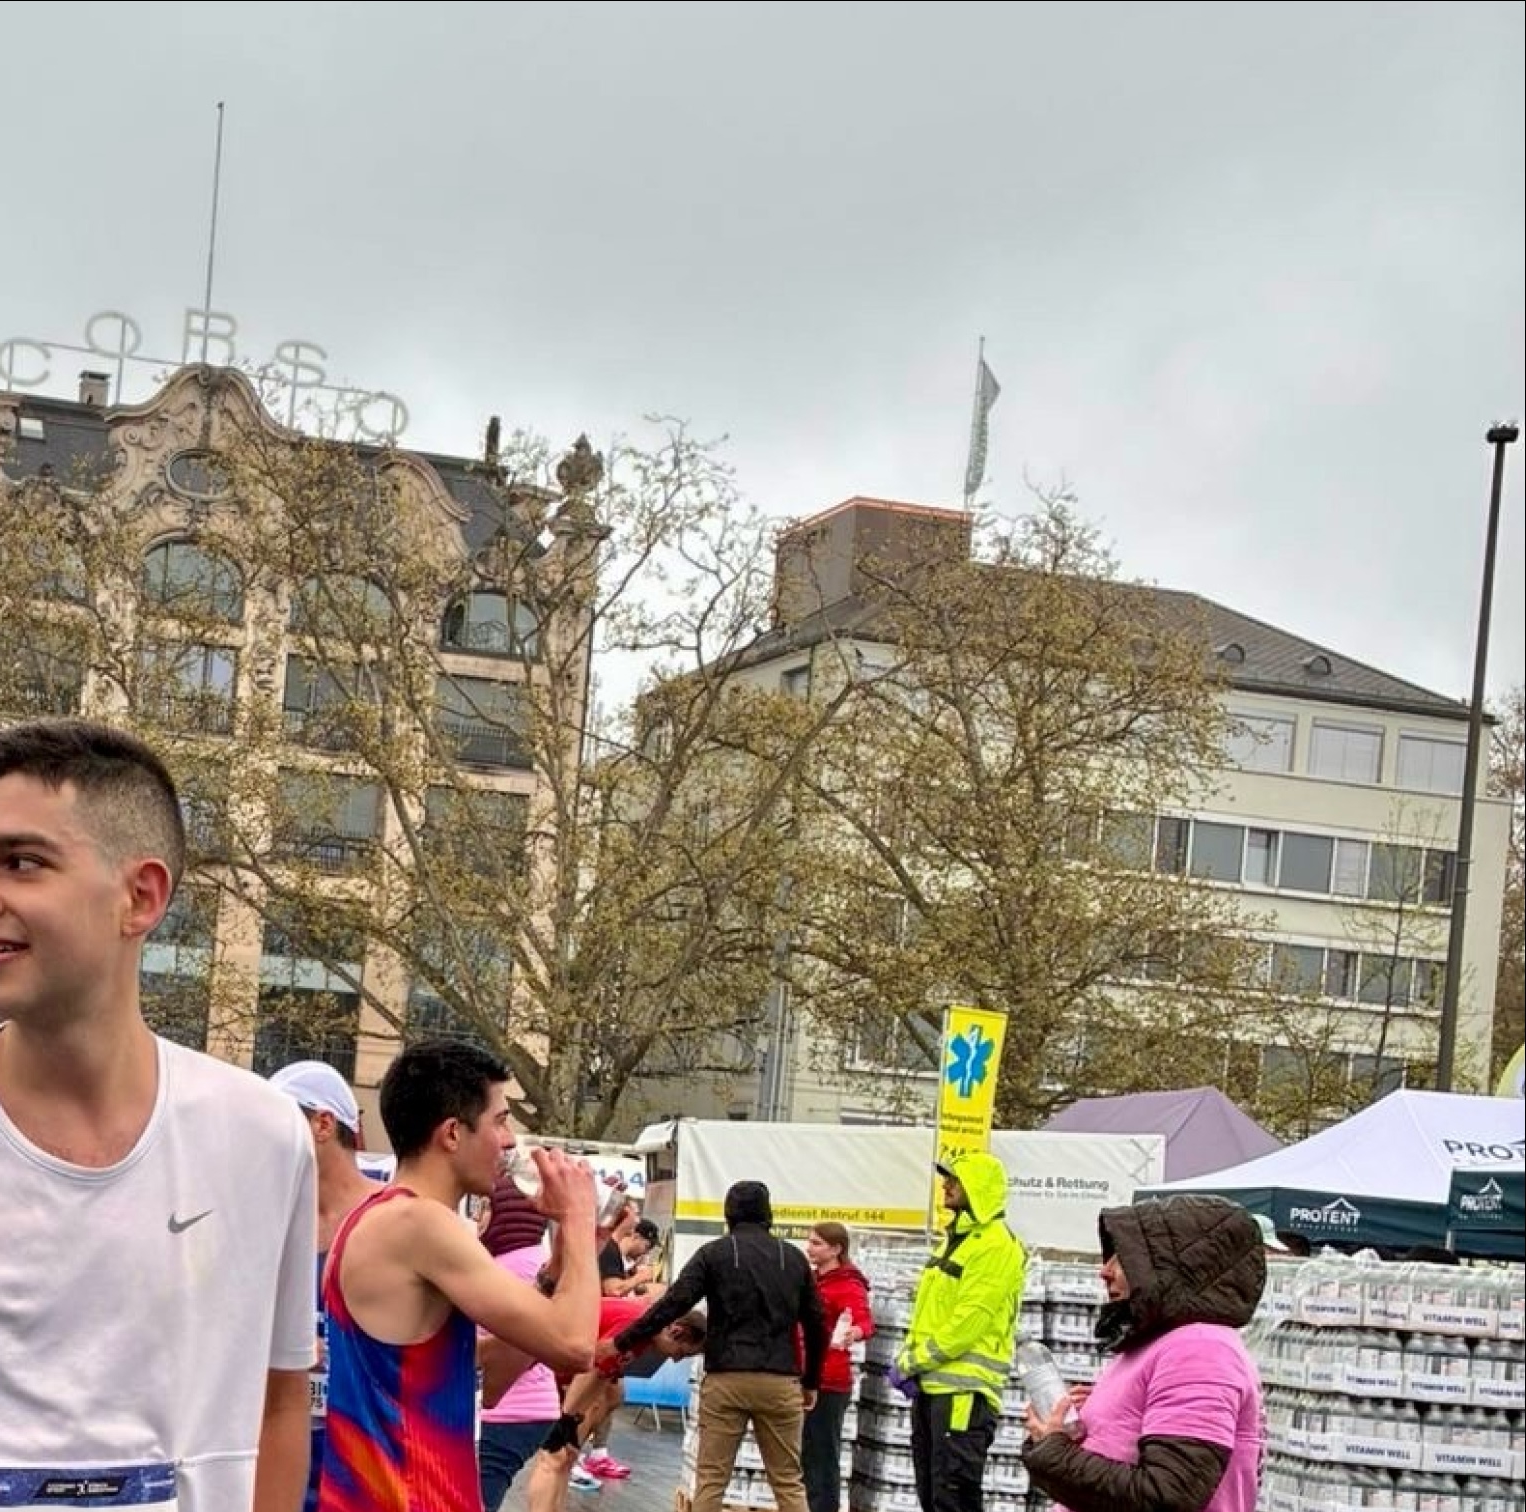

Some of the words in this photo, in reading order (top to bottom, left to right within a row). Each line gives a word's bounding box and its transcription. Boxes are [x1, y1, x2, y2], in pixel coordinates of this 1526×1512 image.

[1289, 1206, 1361, 1226] PROTENT
[1423, 1314, 1462, 1325] VITAMIN
[1464, 1316, 1488, 1327] WELL
[1345, 1445, 1385, 1457] VITAMIN
[1387, 1449, 1411, 1460] WELL
[1436, 1453, 1477, 1466] VITAMIN
[1479, 1457, 1502, 1468] WELL
